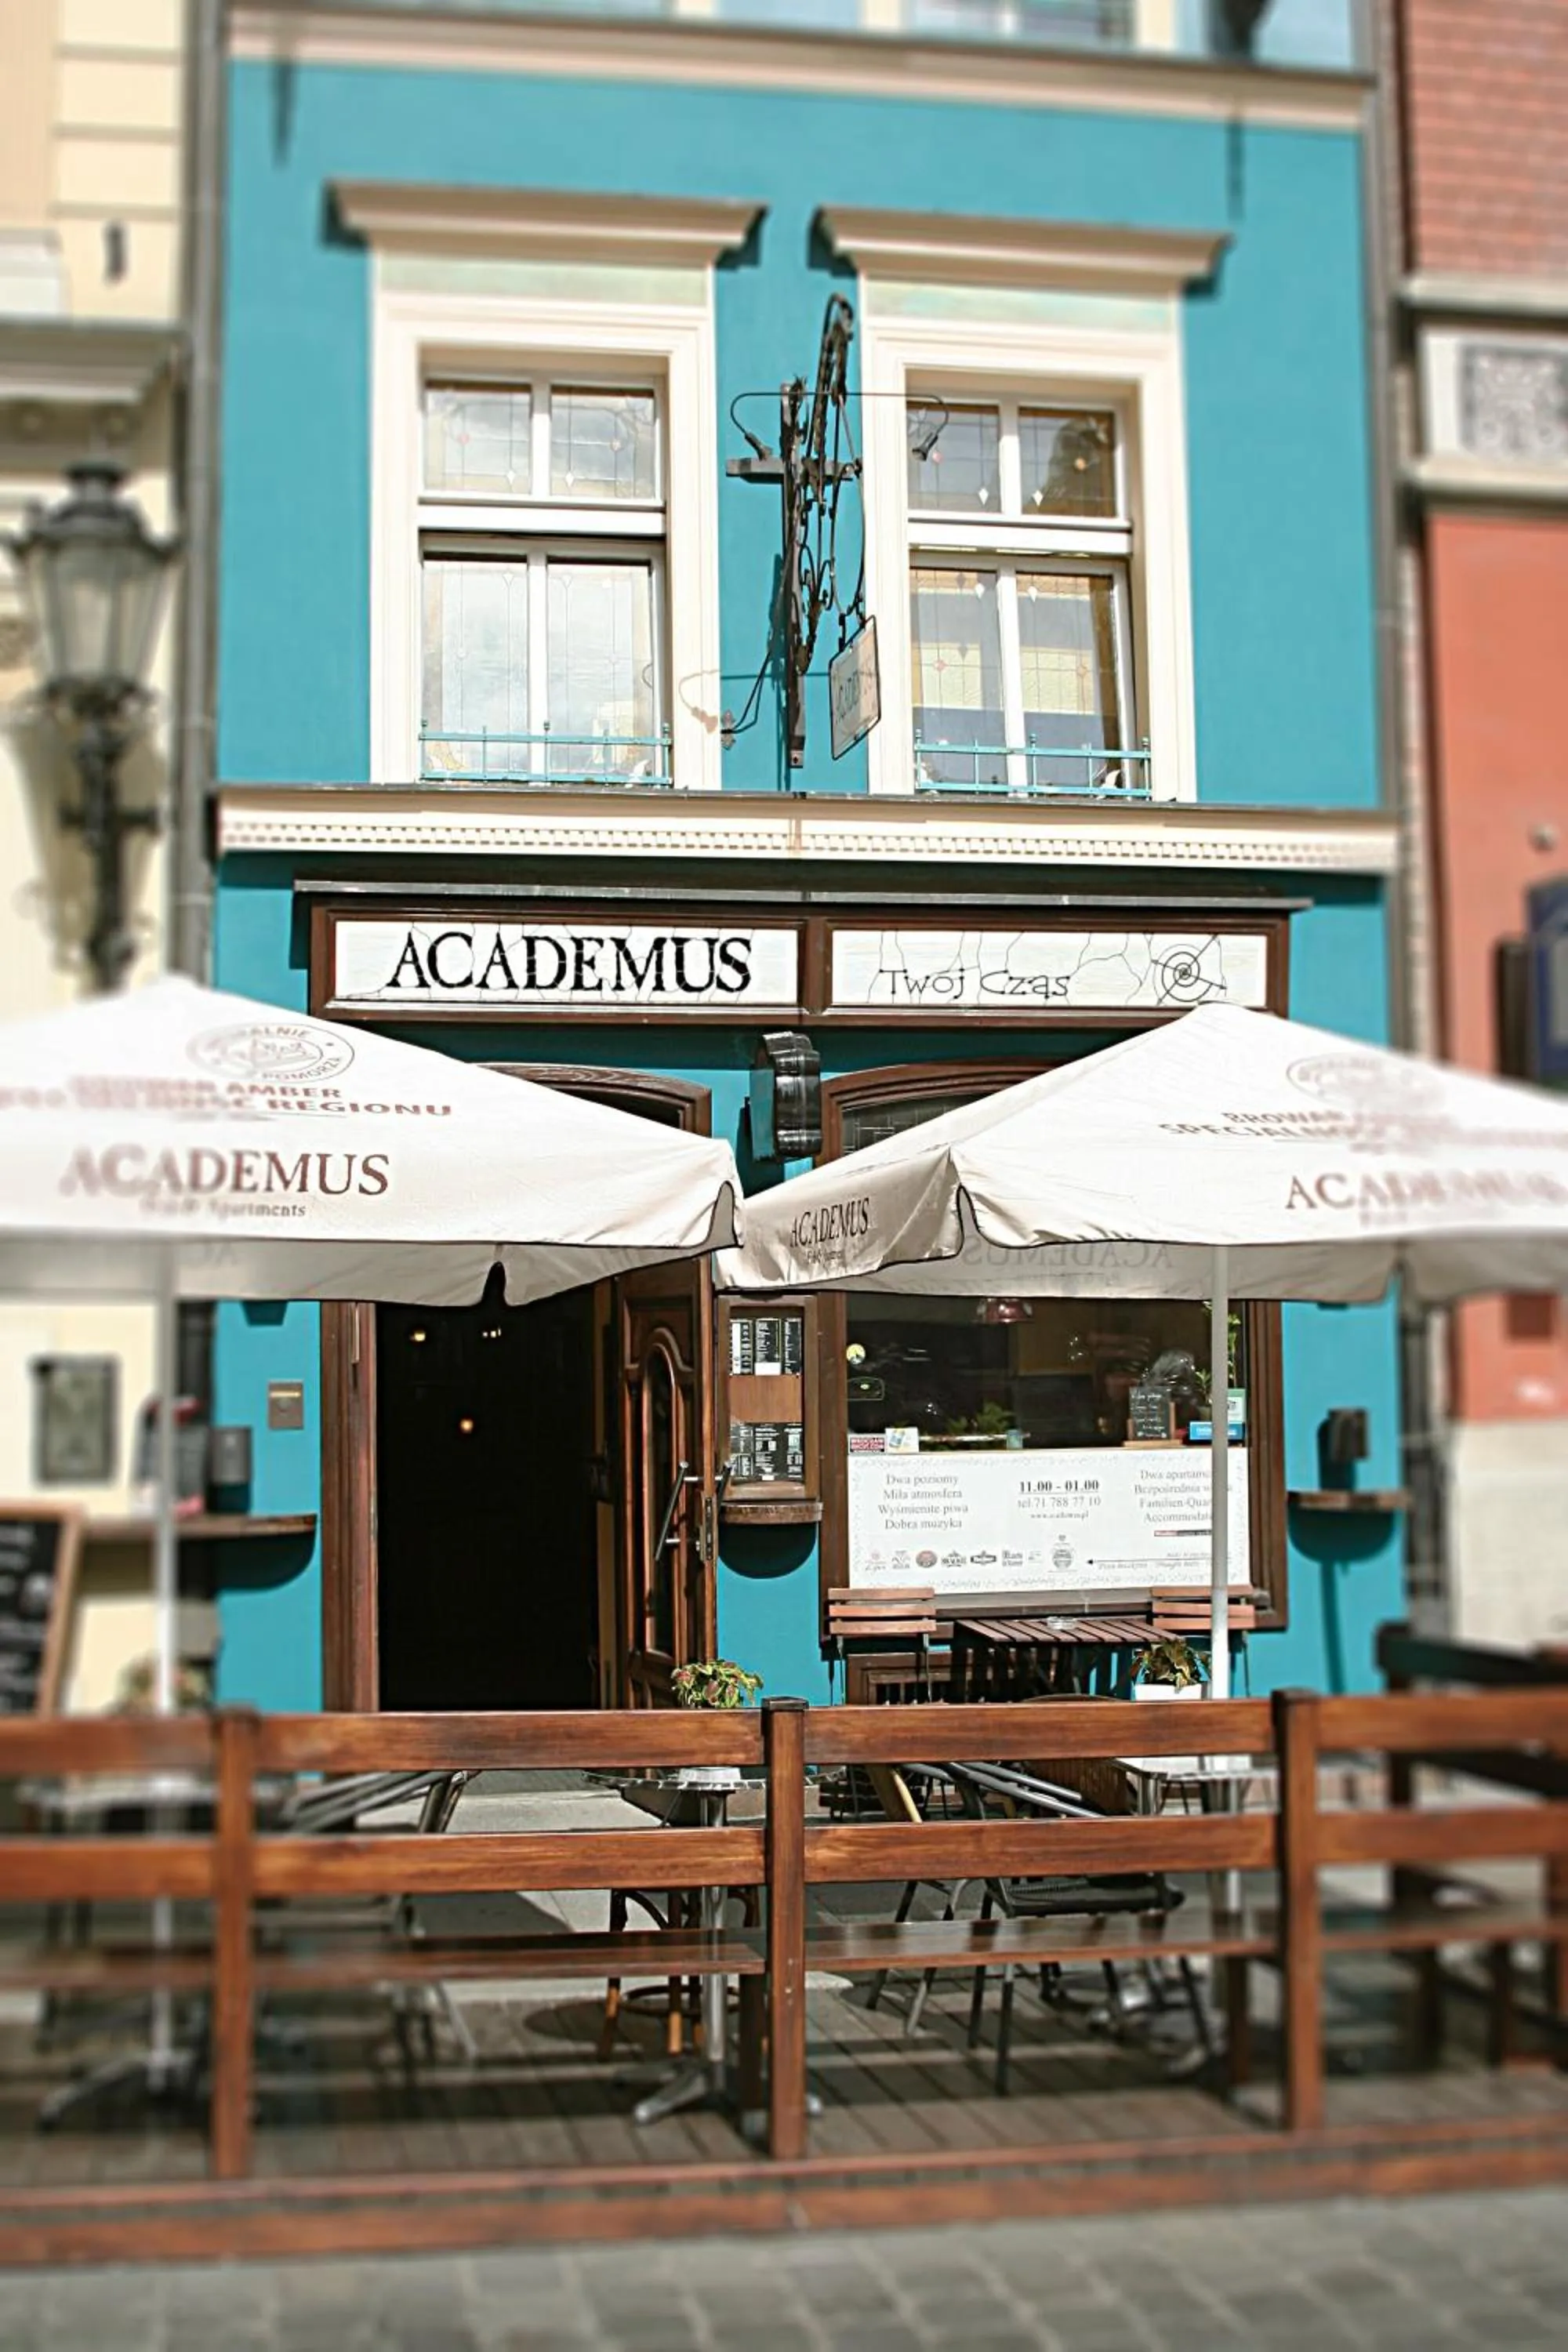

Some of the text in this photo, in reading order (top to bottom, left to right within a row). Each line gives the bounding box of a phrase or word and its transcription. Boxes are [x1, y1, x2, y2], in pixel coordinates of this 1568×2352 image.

[387, 931, 752, 993] ACADEMUS
[225, 1082, 343, 1098] AMBER
[267, 1099, 452, 1118] REGIONU
[57, 1142, 390, 1196] ACADEMUS
[789, 1197, 869, 1247] ACADEMUS
[1020, 1480, 1052, 1492] 11.00
[1065, 1479, 1099, 1491] 01.00
[884, 1518, 962, 1530] Dobra muzyka
